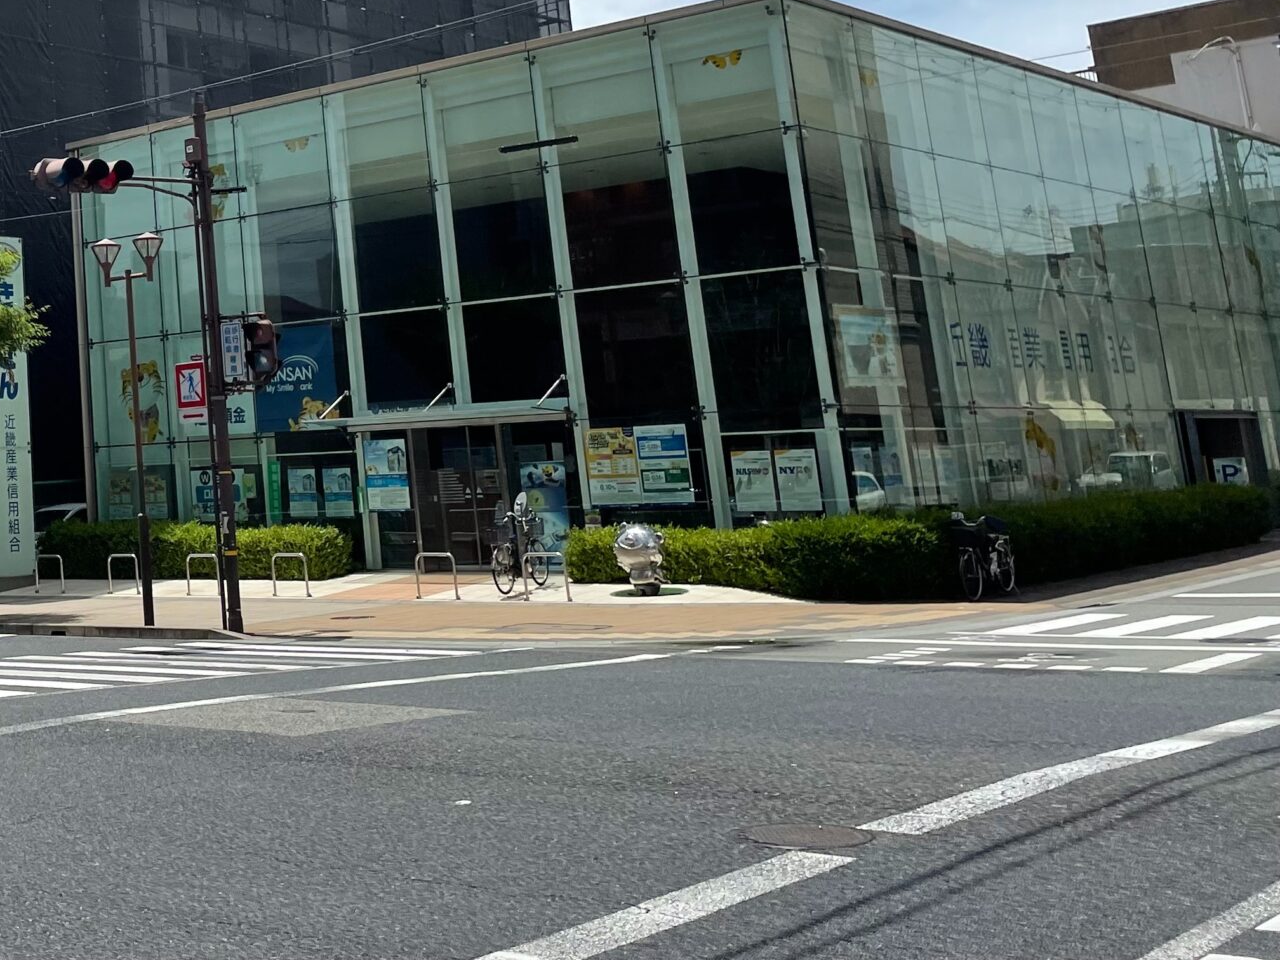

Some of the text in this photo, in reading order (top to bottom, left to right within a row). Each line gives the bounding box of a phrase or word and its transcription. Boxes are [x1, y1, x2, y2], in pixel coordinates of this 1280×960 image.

[4, 414, 21, 553] 近畿産業信用組合
